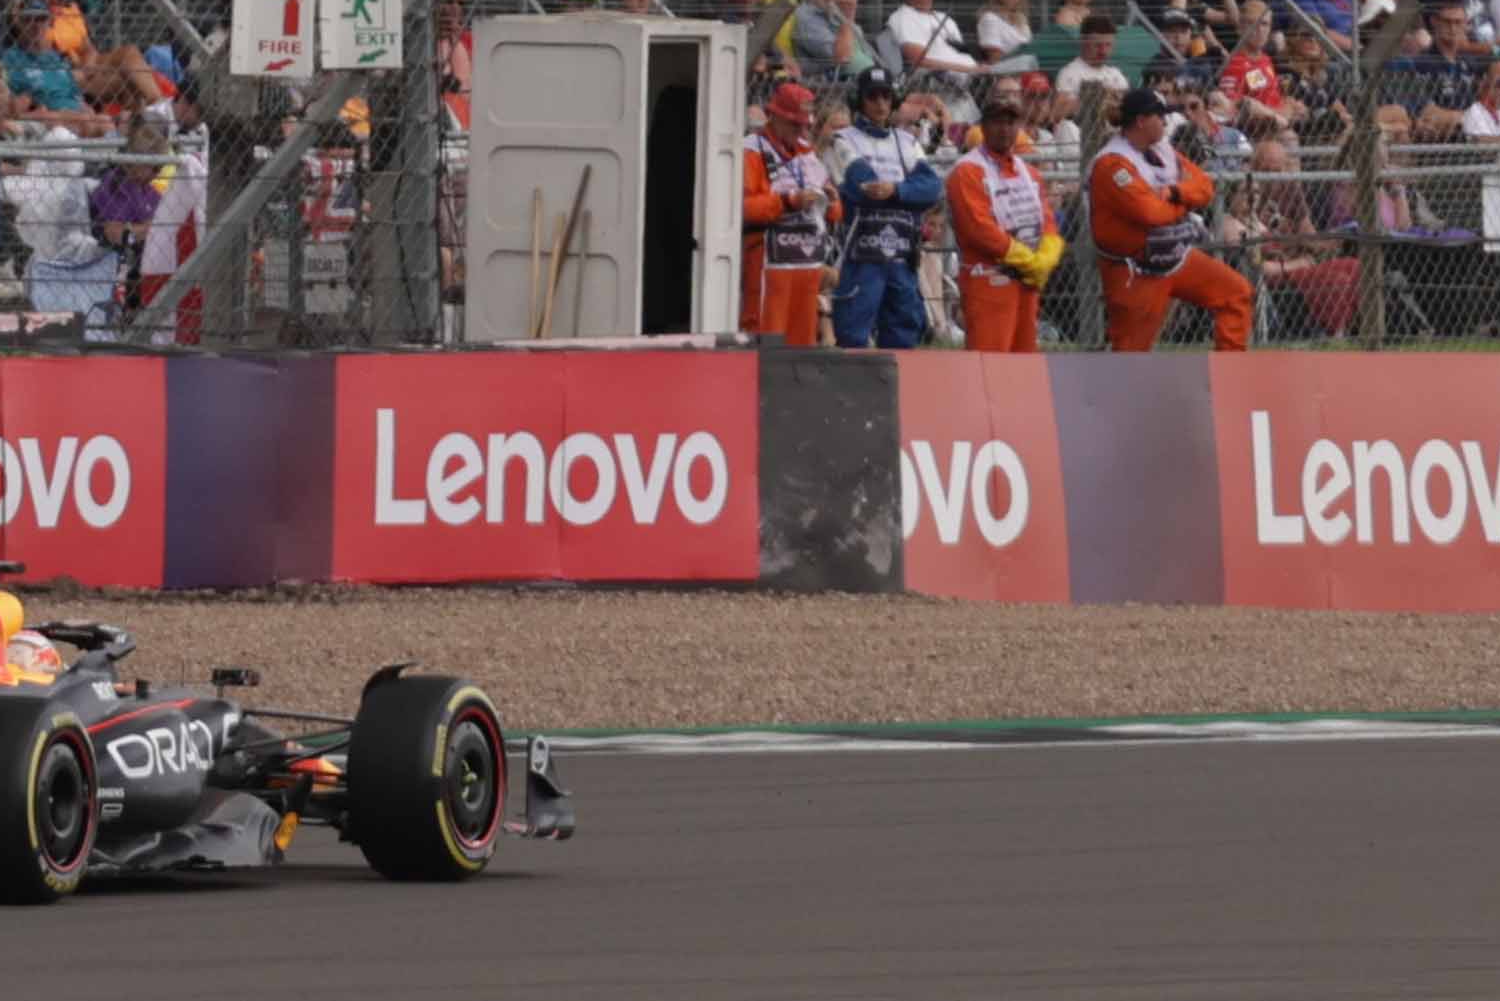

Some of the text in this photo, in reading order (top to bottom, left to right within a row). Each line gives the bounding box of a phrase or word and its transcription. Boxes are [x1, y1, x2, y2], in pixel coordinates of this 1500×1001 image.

[257, 39, 303, 56] FIRE
[355, 32, 399, 46] EXIT
[375, 408, 728, 525] Lenovo
